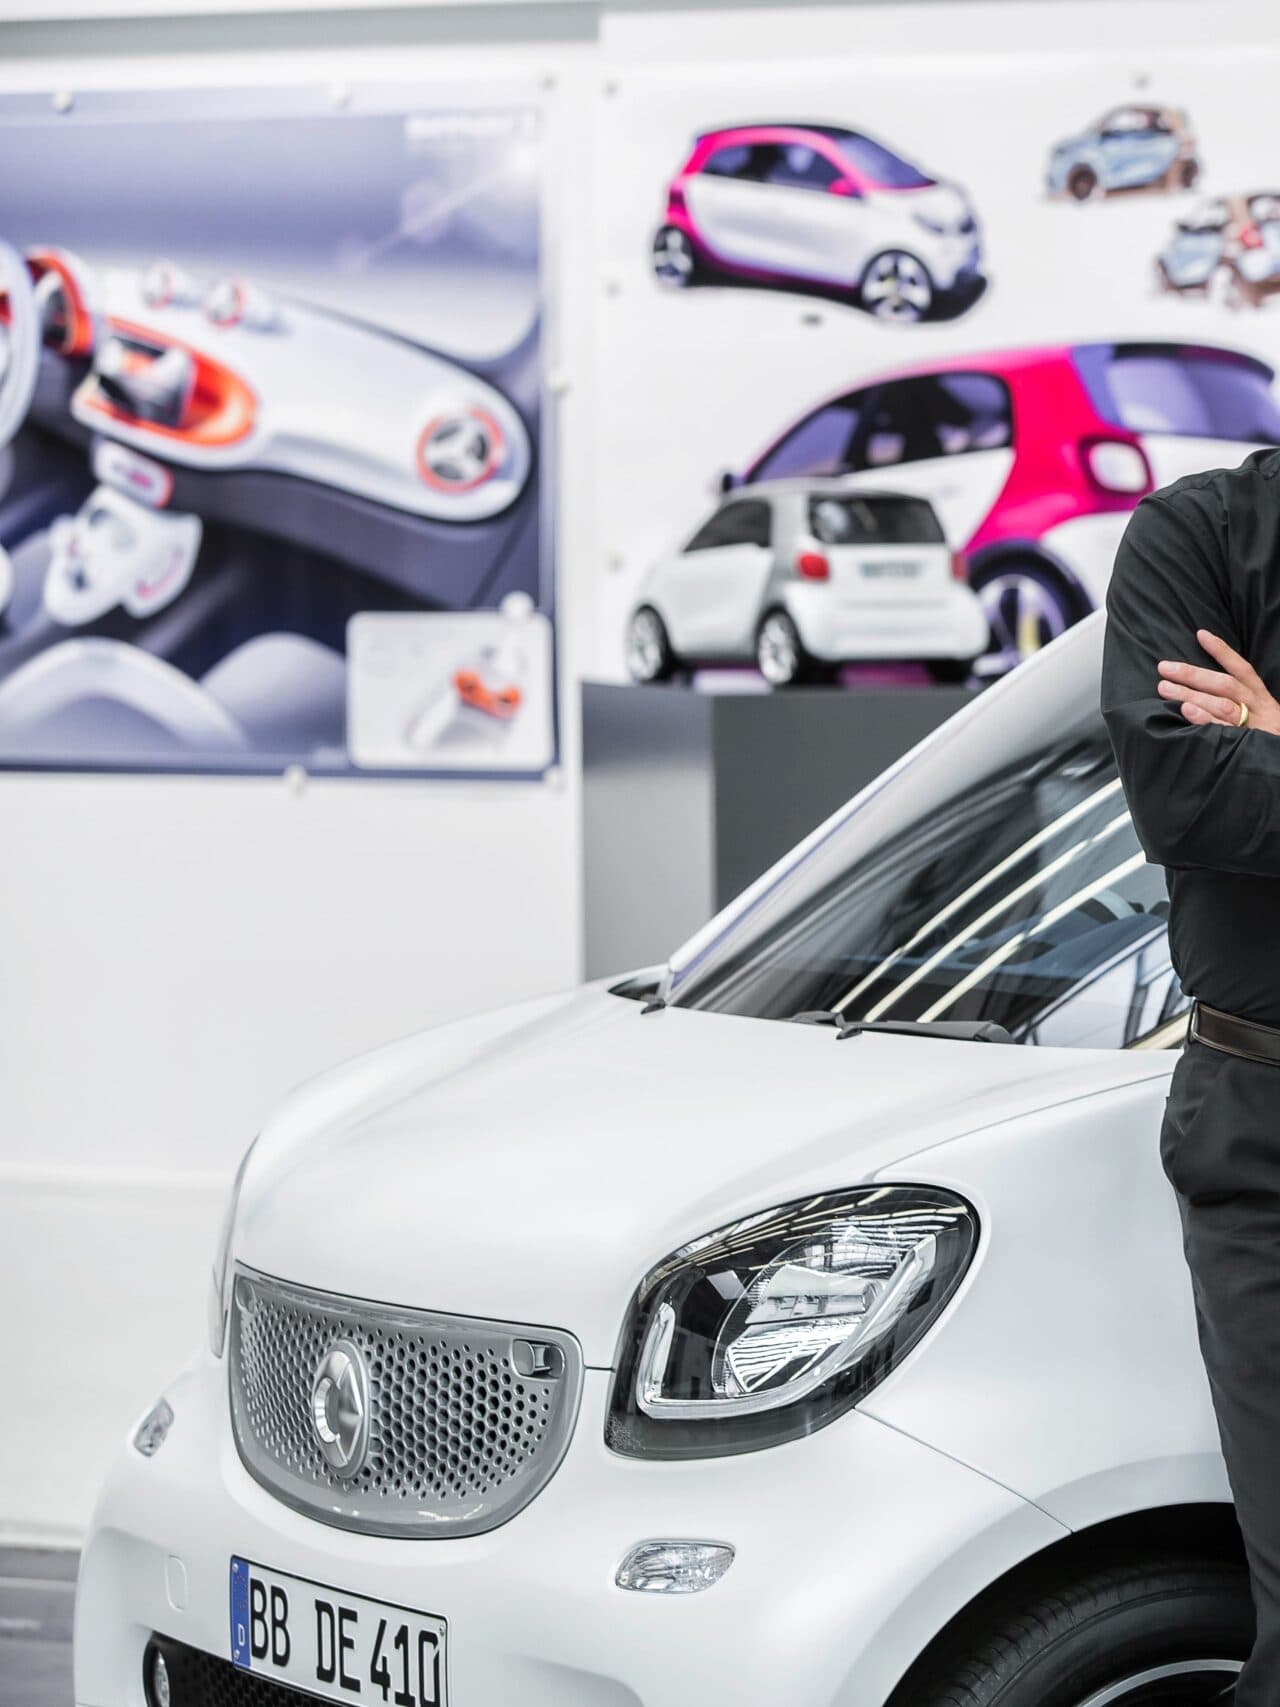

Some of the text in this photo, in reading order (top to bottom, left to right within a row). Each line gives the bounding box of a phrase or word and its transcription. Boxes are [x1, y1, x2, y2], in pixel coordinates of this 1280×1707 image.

[237, 1623, 246, 1646] D
[250, 1578, 440, 1707] BB DE 410
